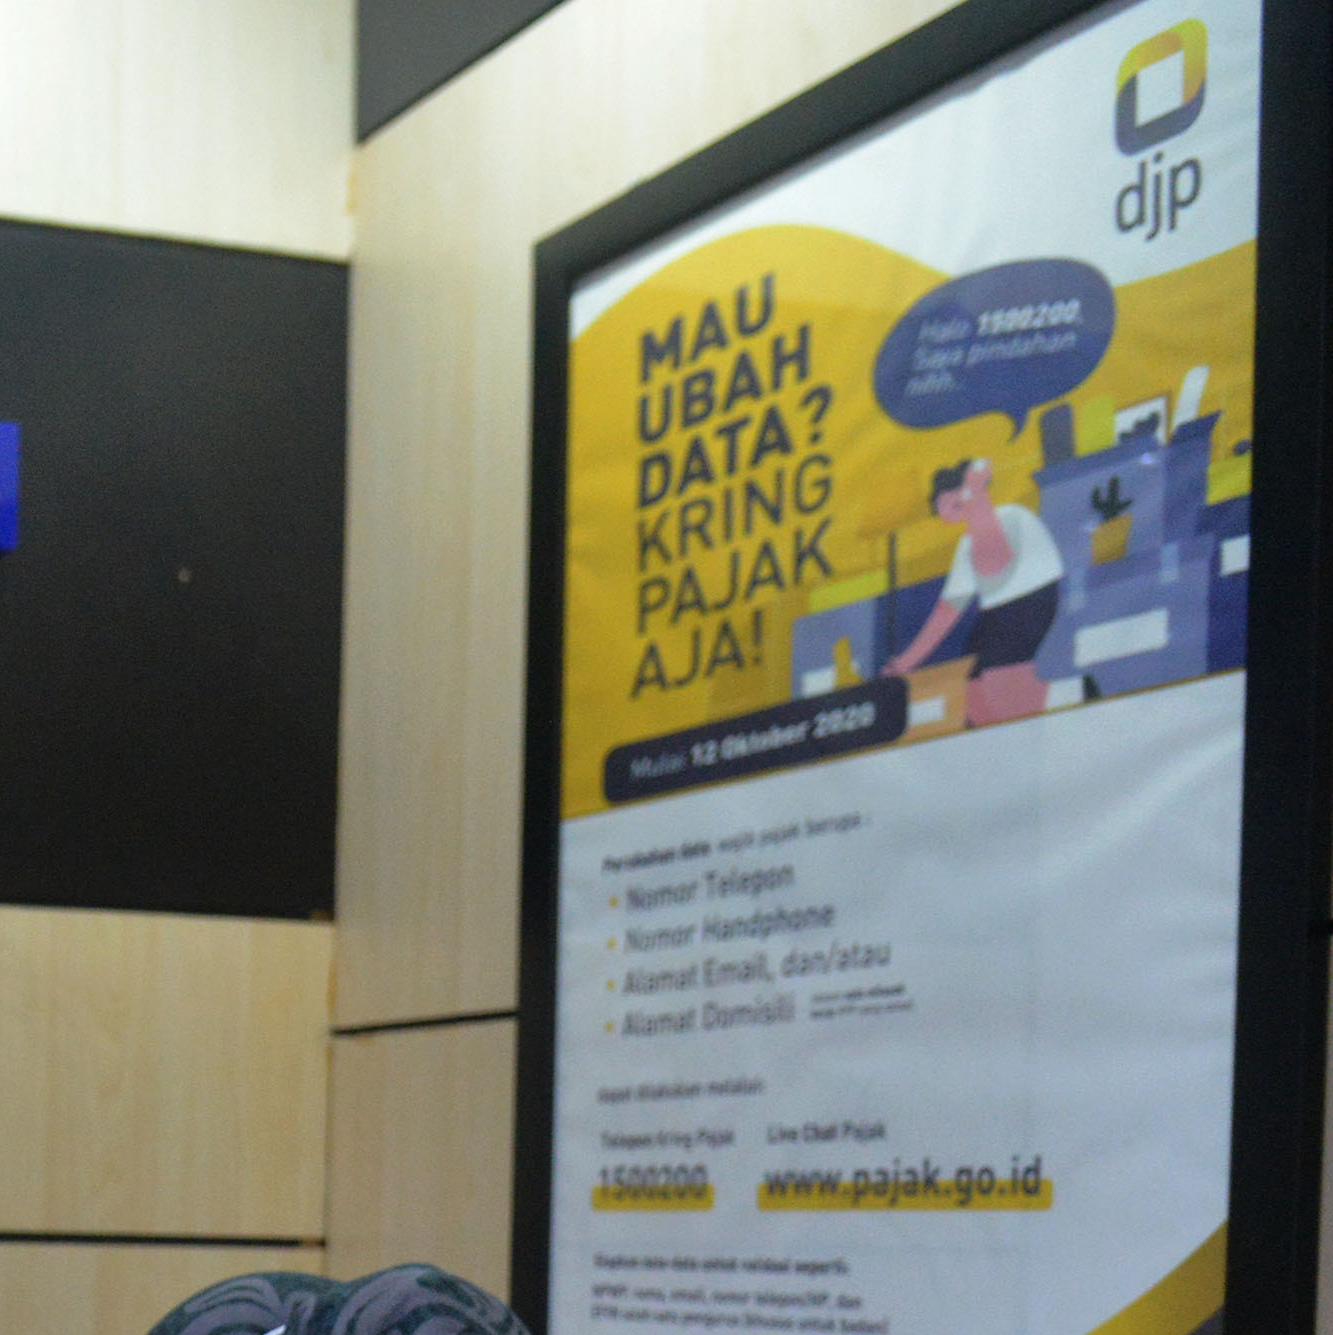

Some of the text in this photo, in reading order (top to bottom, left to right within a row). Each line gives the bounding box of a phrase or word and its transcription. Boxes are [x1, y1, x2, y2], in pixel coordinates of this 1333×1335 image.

[1115, 152, 1203, 241] djp
[640, 270, 775, 385] MAU
[638, 322, 811, 443] UBAH
[638, 386, 833, 509] DATA?
[637, 453, 833, 573] KRING
[637, 516, 833, 635] PAJAK
[629, 608, 763, 700] AJA!
[626, 864, 796, 912] Nomor Telepon
[625, 903, 836, 952] Nomor Handphone
[623, 964, 699, 995] Alamat
[779, 938, 893, 979] dan/atau
[622, 1007, 697, 1037] Alamat
[765, 1119, 886, 1145] Live Chat Pajak
[598, 1161, 709, 1202] 1500200
[764, 1153, 1044, 1208] www.pajak.go.id
